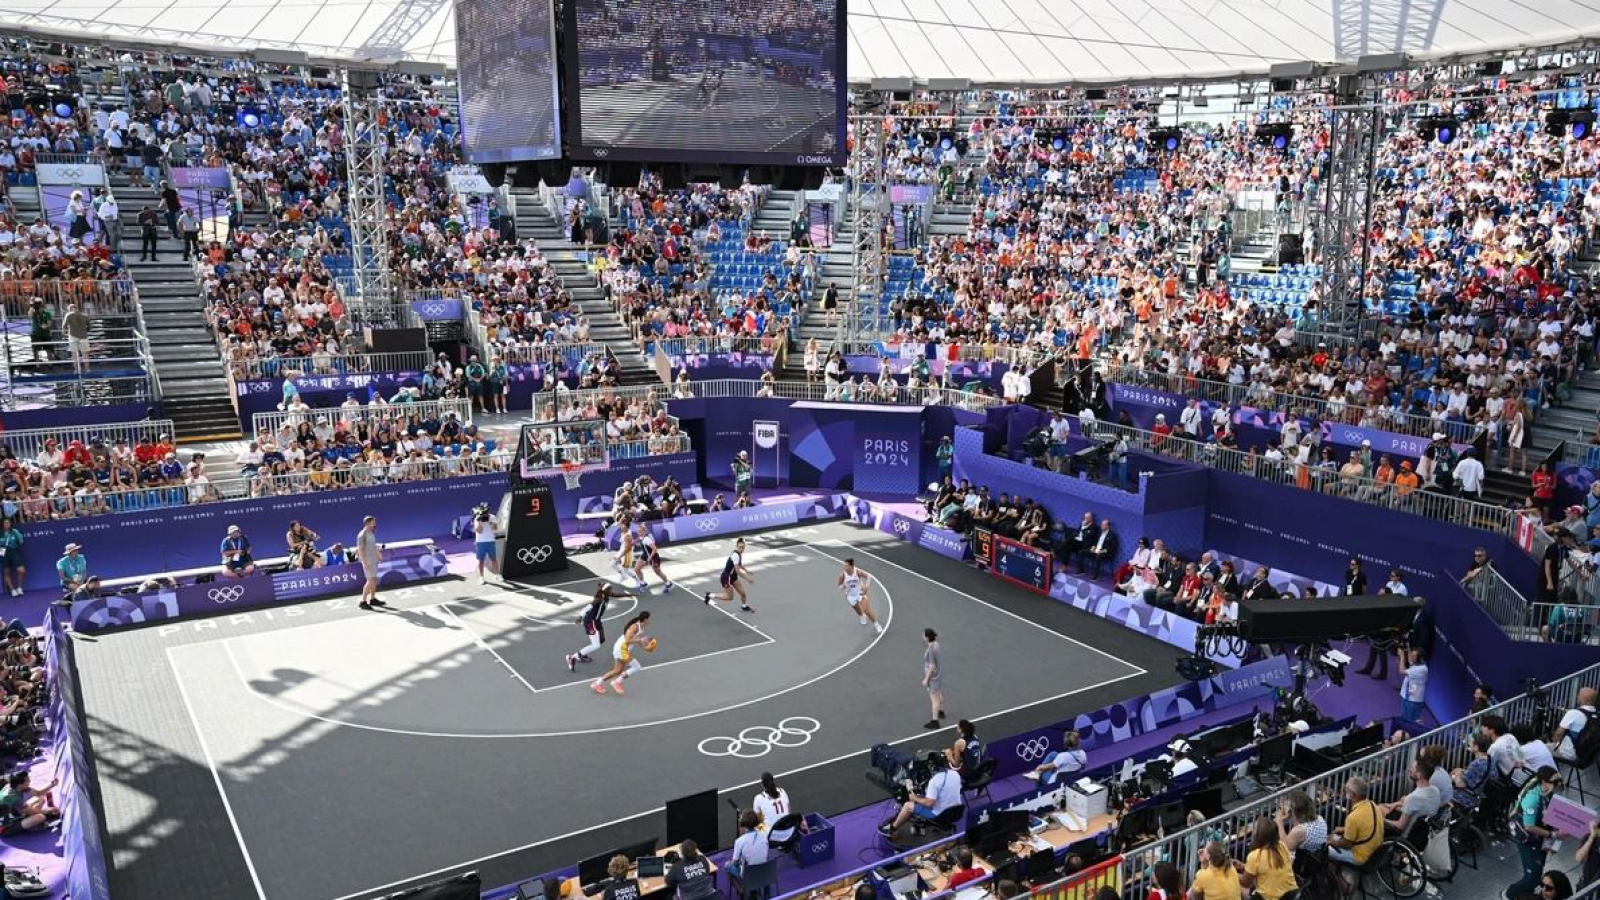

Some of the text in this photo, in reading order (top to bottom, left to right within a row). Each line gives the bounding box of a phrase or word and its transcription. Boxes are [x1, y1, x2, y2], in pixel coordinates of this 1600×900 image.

[805, 156, 832, 164] OMEGA
[1123, 389, 1177, 407] PARIS 2024
[757, 429, 775, 438] FIBA
[865, 439, 909, 453] PARIS
[865, 452, 909, 467] 2024
[532, 498, 540, 511] 9
[742, 509, 793, 524] PARIS 2024
[924, 532, 962, 551] PARIS 2024
[982, 543, 989, 558] 9
[1001, 555, 1007, 563] 4
[1034, 566, 1041, 577] 6
[281, 573, 357, 590] PARIS 2024
[157, 603, 306, 638] PARIS
[1230, 669, 1285, 692] PARIS 2024
[773, 800, 784, 815] 11
